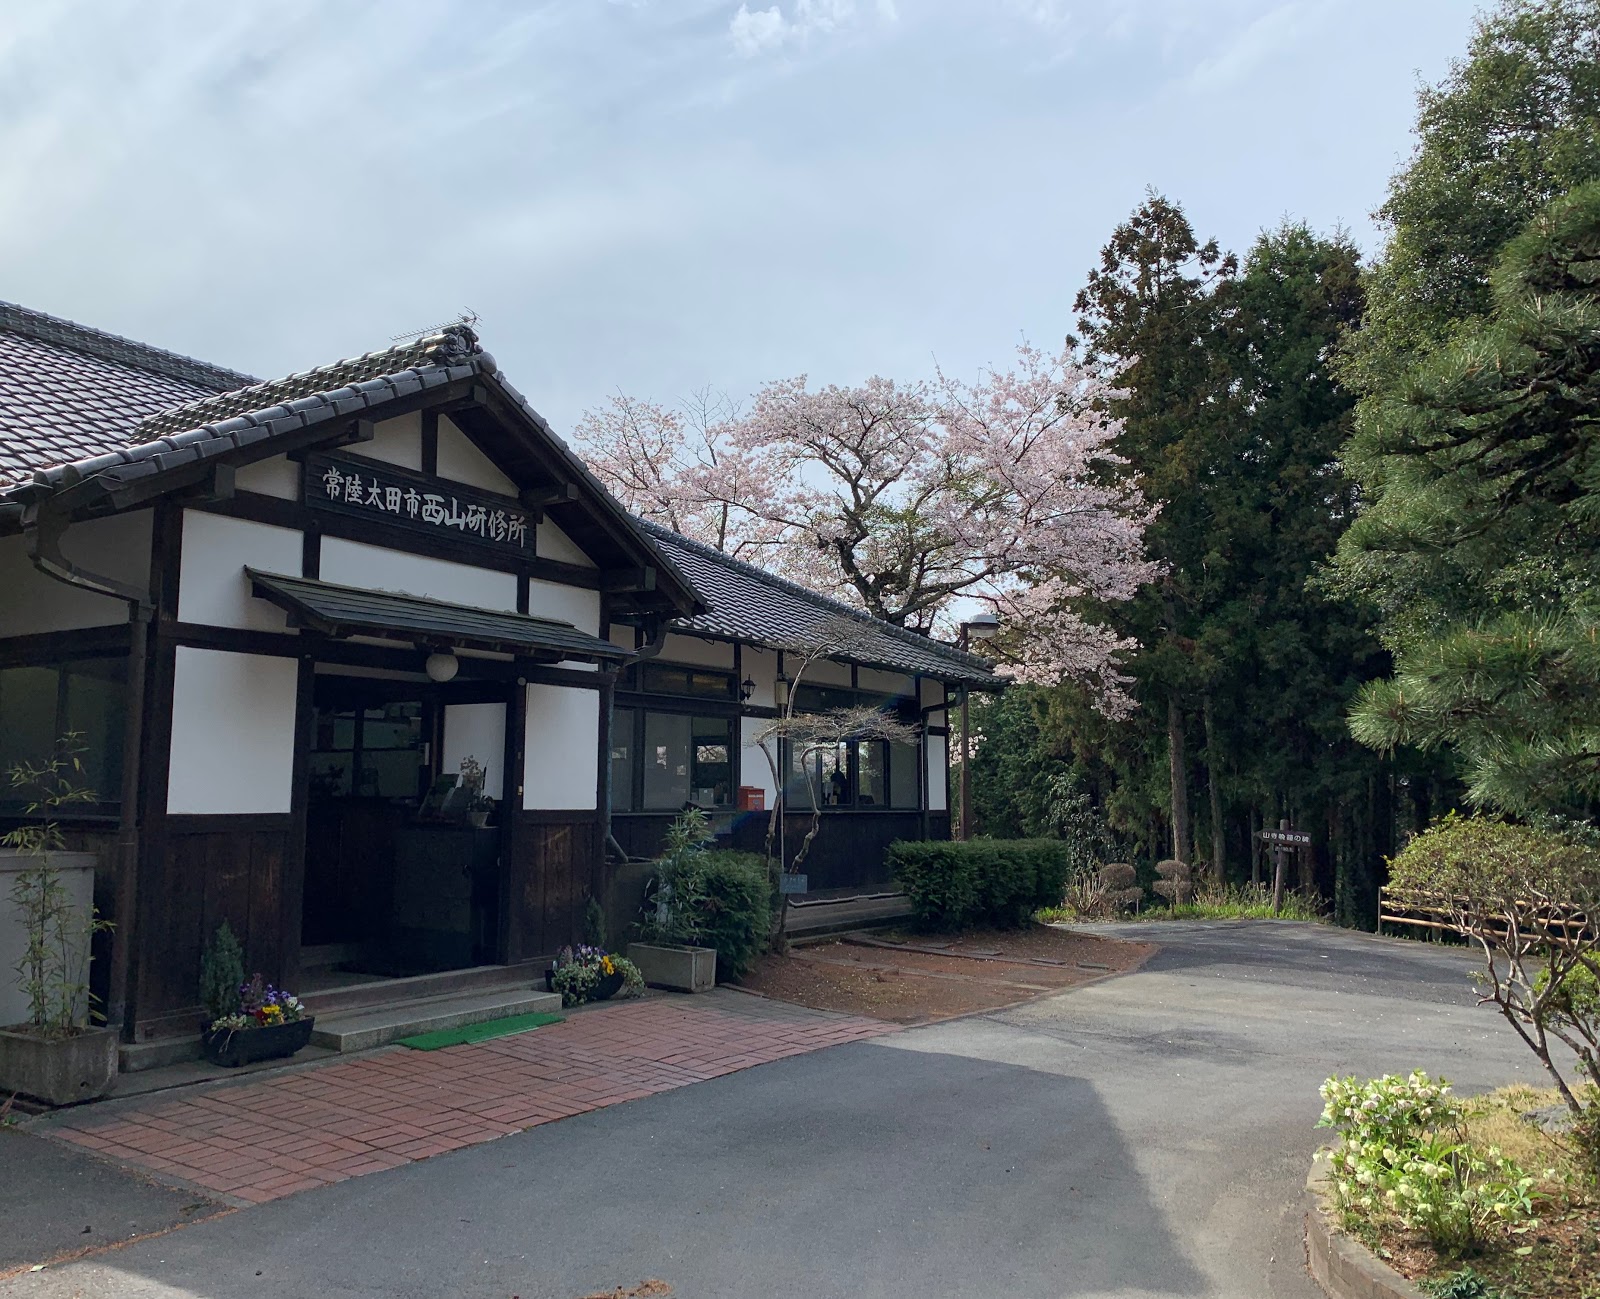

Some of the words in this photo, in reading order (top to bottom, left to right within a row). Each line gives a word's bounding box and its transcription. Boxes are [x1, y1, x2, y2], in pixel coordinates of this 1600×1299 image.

[322, 466, 528, 548] 常陸太田市西山研修所
